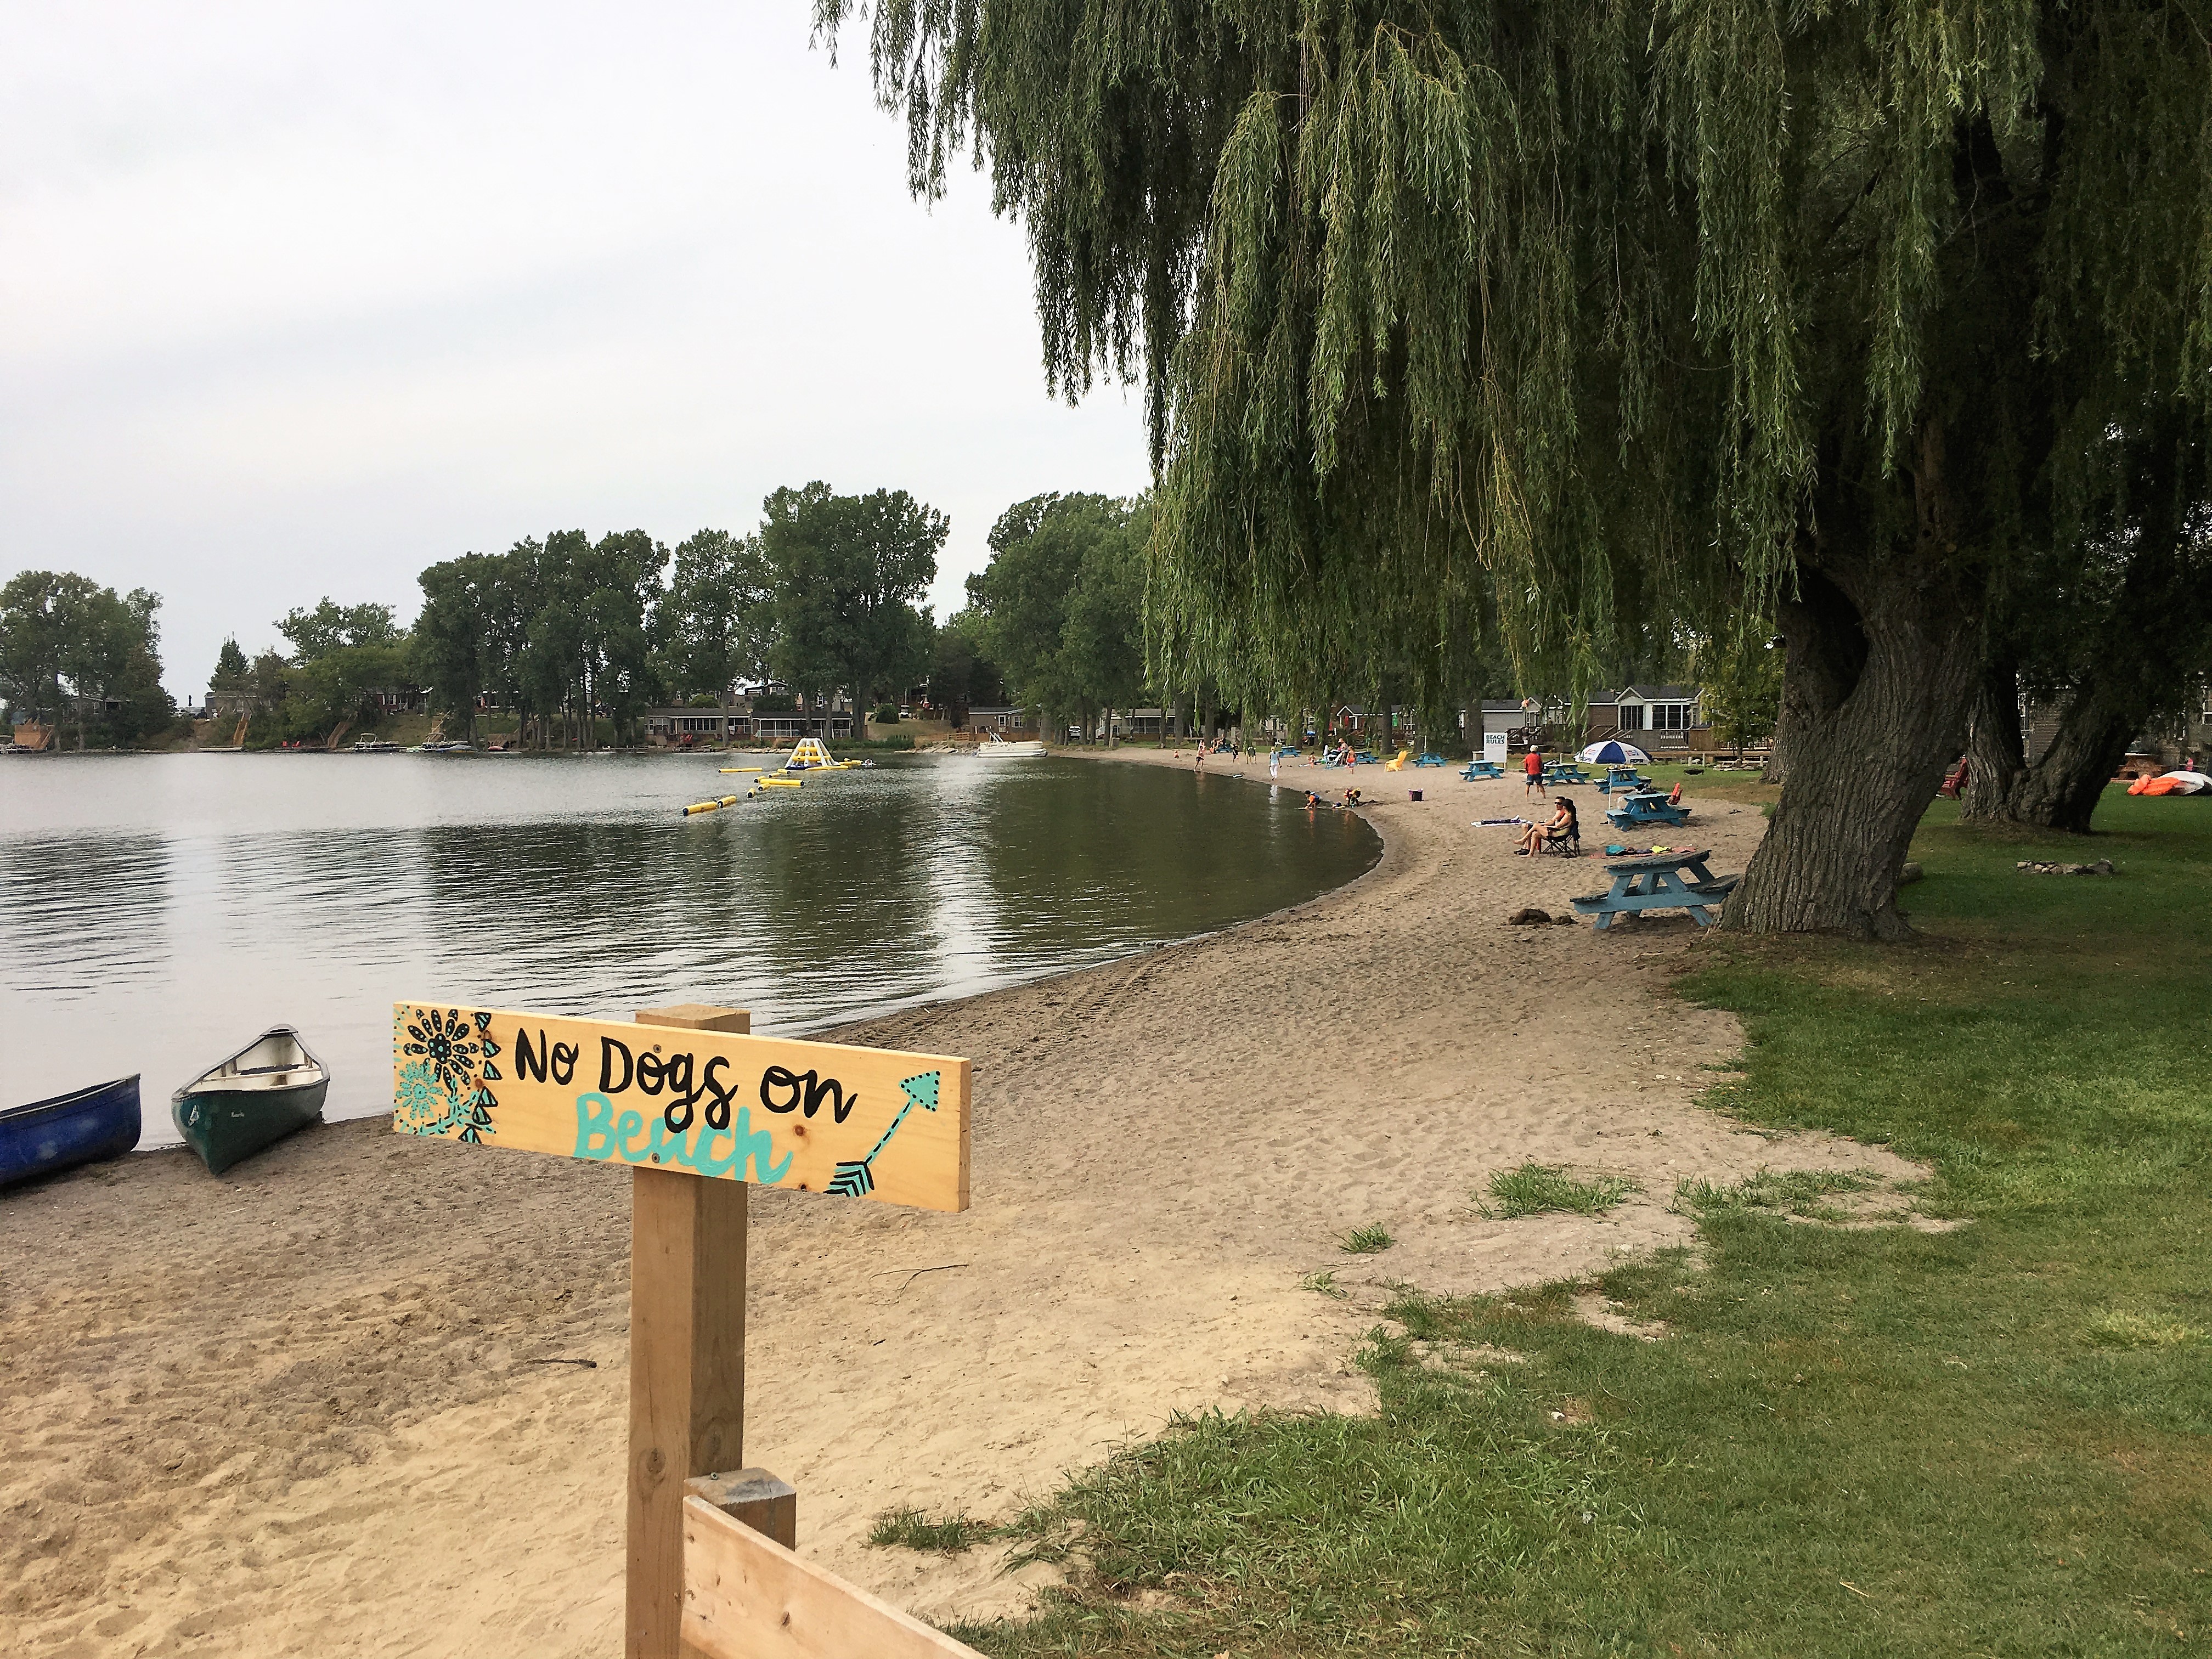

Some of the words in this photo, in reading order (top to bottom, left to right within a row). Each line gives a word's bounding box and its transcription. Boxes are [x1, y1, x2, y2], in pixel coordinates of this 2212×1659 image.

[515, 1028, 579, 1085] No
[599, 1036, 738, 1133] Dogs
[760, 1065, 858, 1124] on
[573, 1092, 793, 1184] Beach
